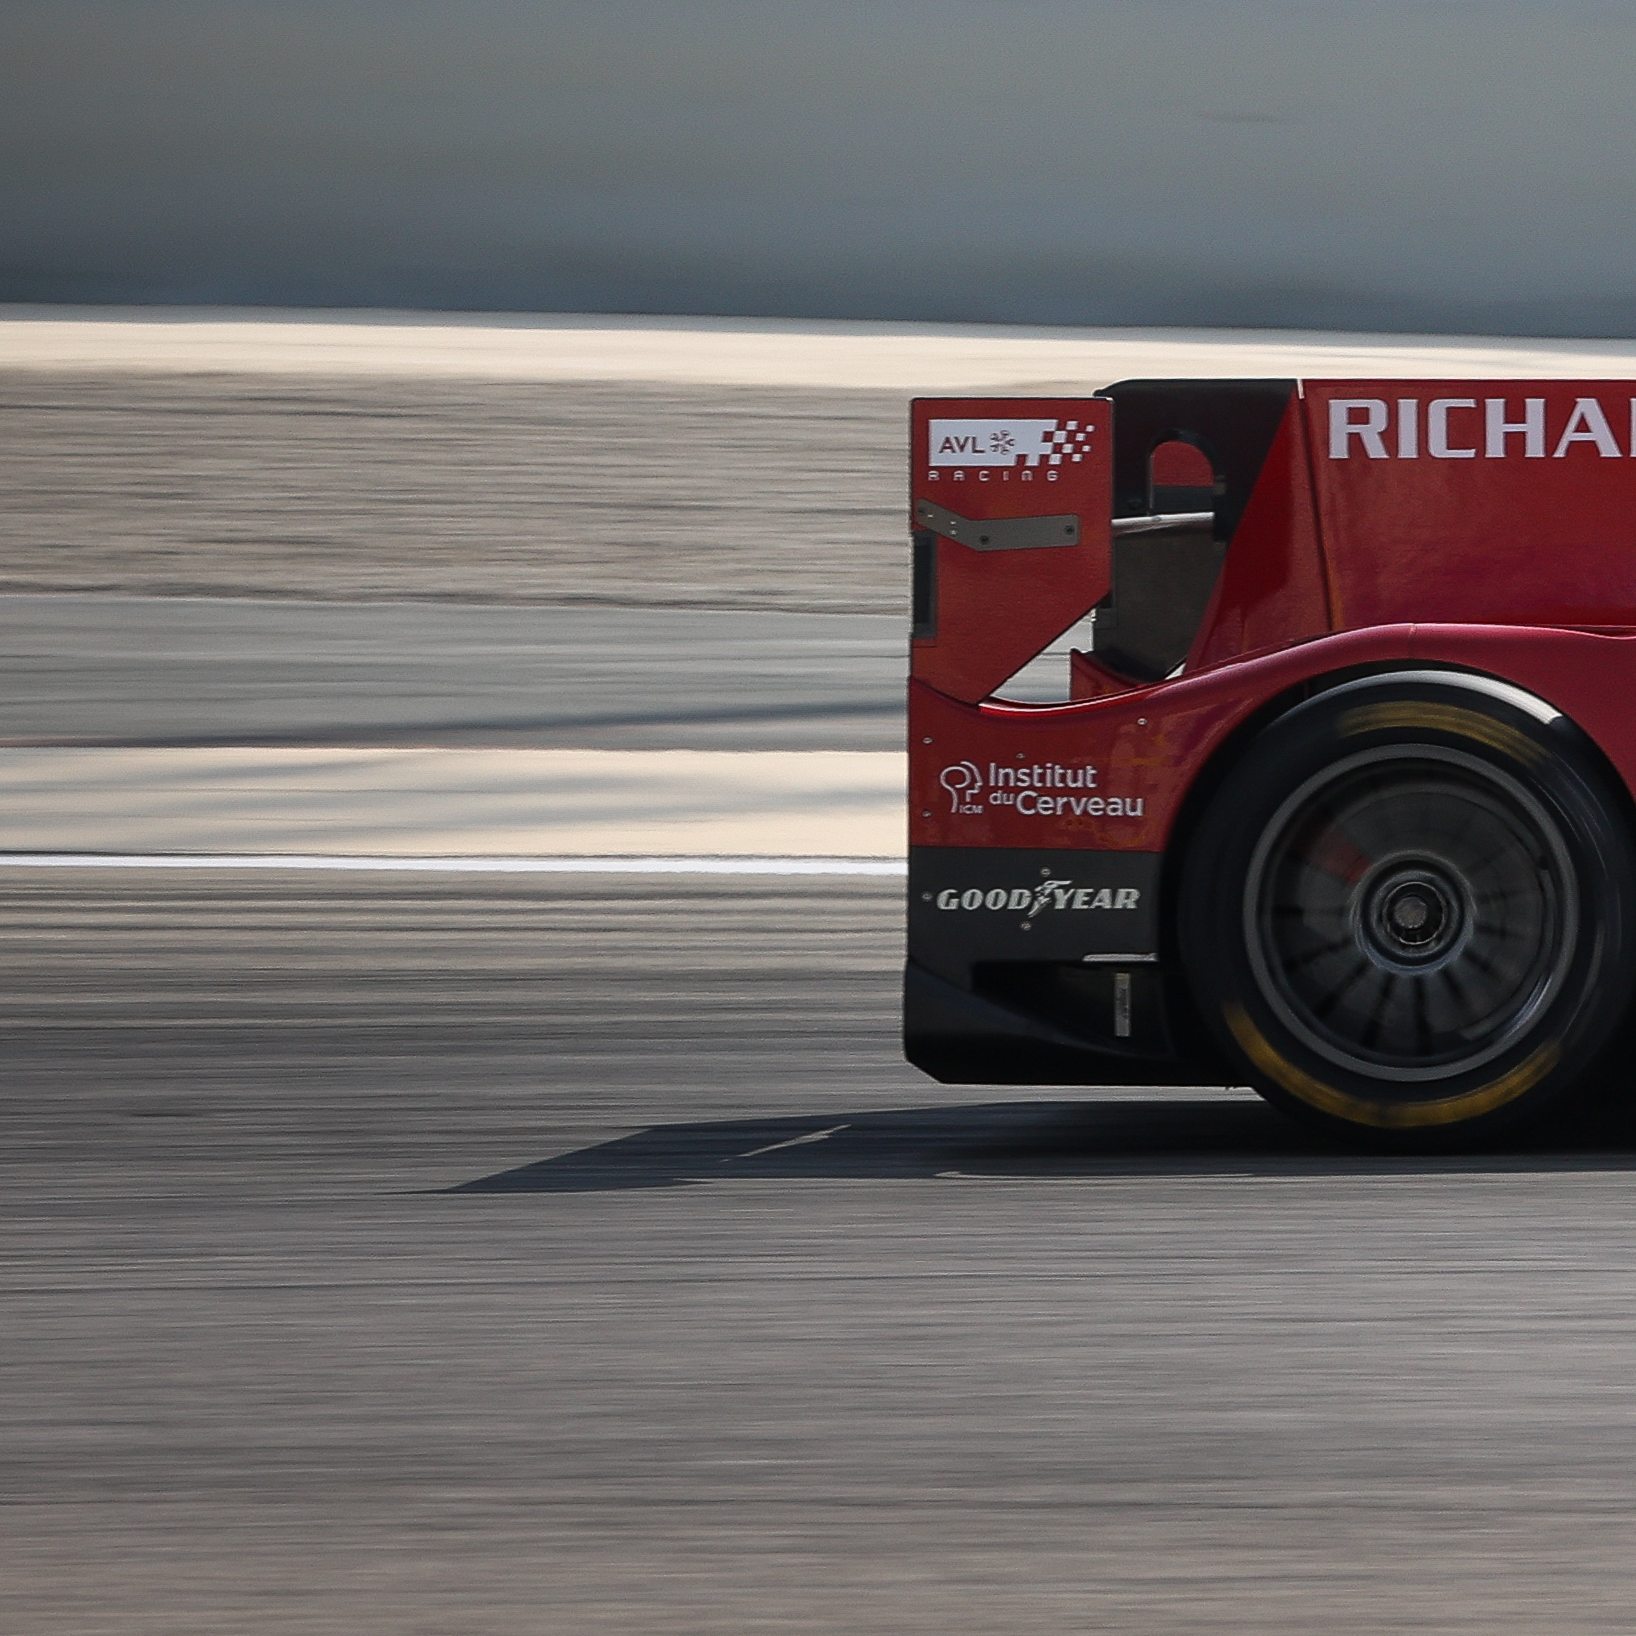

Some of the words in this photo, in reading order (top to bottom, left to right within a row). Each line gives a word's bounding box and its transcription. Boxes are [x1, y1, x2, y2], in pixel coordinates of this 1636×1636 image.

[938, 436, 986, 454] AVL
[928, 470, 1059, 481] RACING
[988, 762, 1097, 788] Institut
[959, 804, 984, 814] ICM
[988, 790, 1014, 805] du
[1016, 790, 1144, 816] Cerveau
[936, 883, 1140, 914] GOODYEAR
